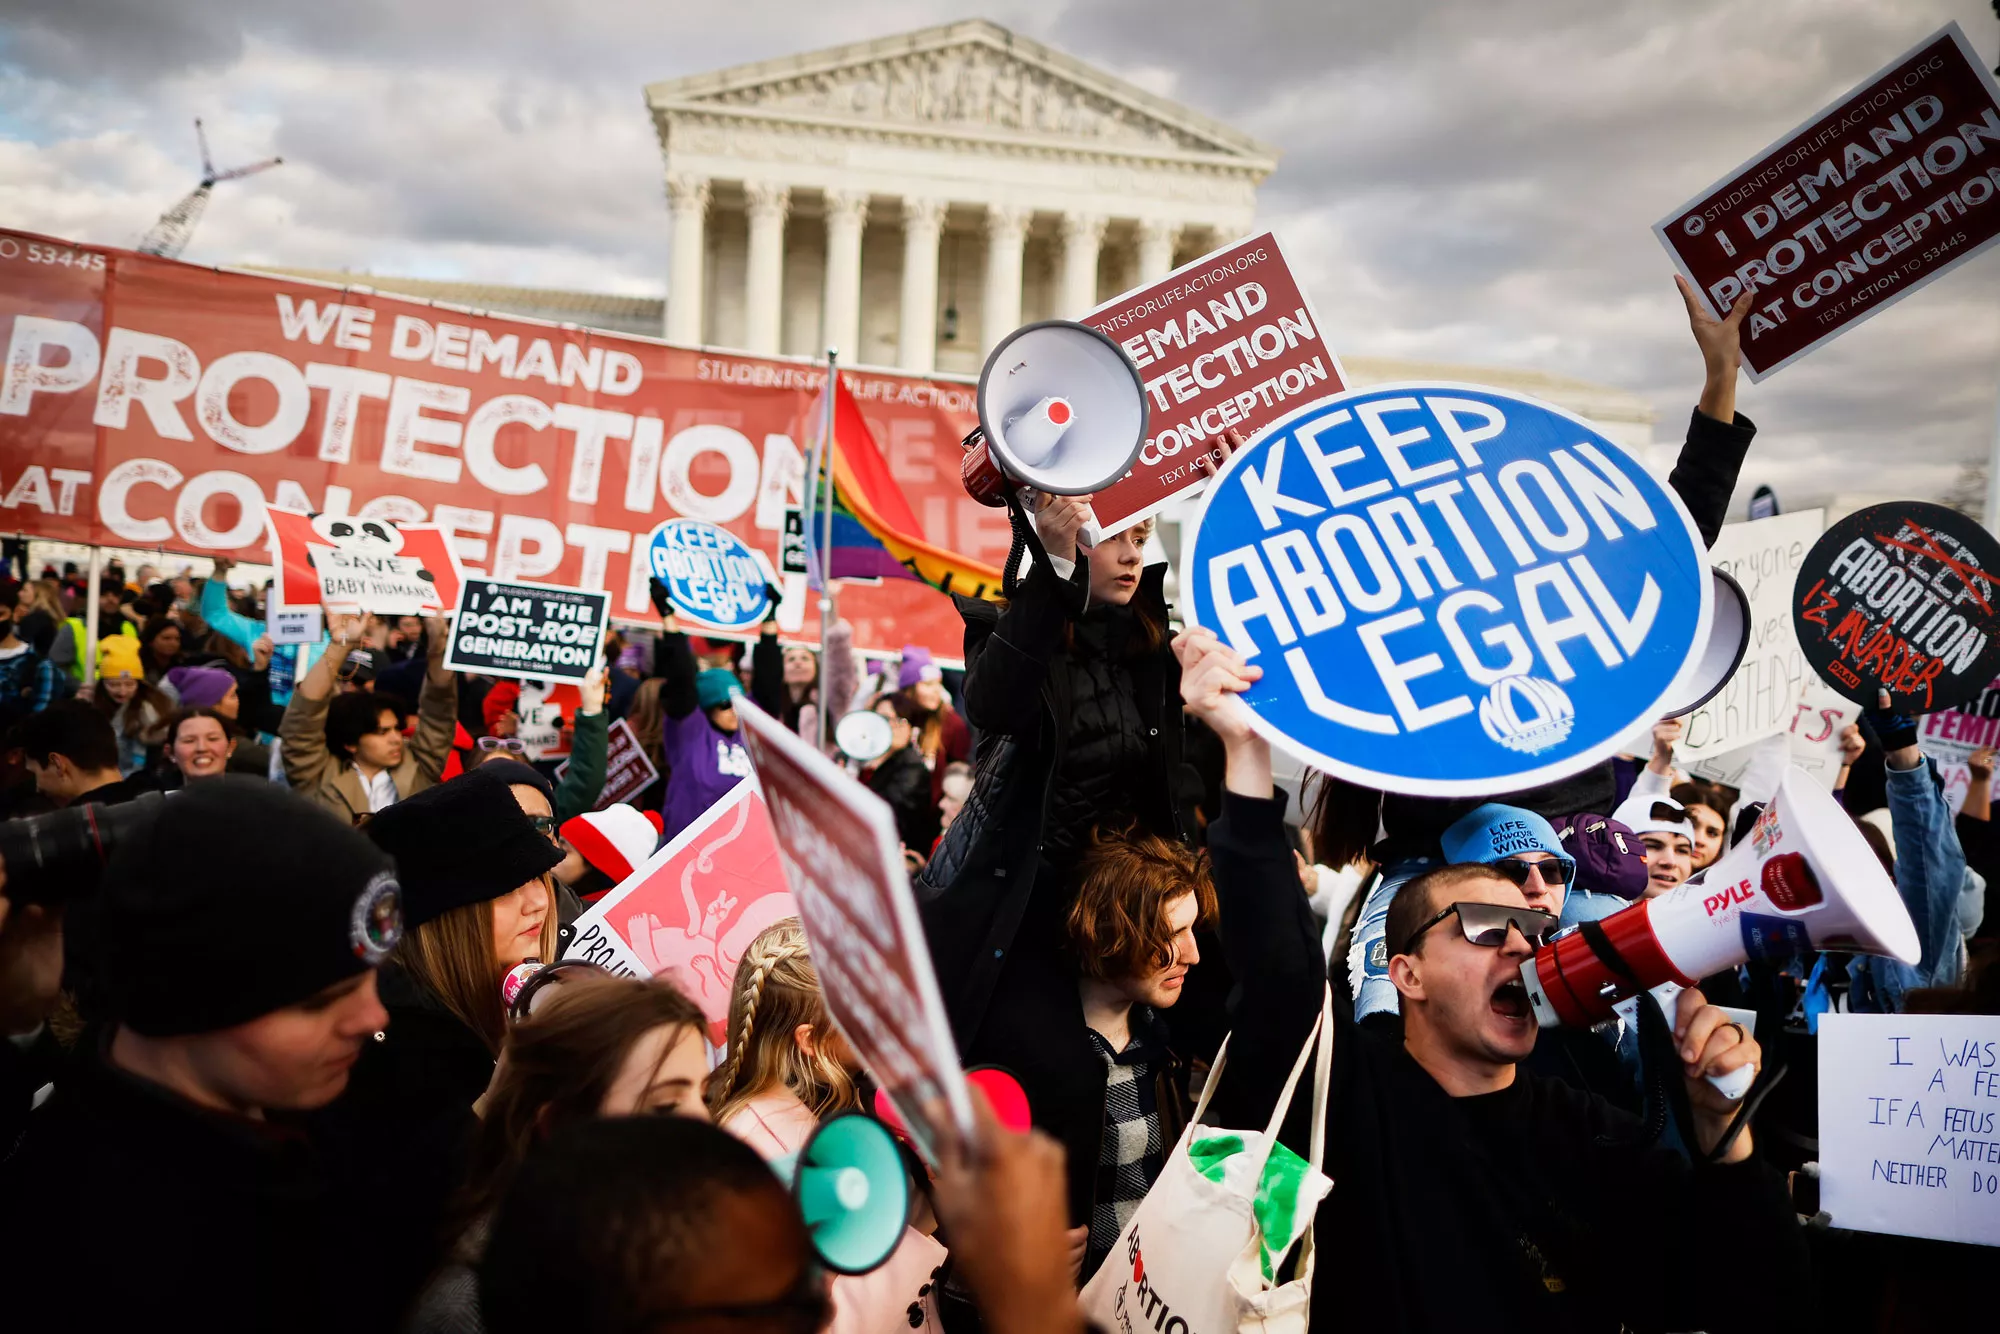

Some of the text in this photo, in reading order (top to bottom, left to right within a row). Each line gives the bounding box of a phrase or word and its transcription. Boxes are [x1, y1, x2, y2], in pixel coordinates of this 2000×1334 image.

[1705, 55, 1944, 222] STUDENTSFORLIFEACTION.ORG
[1715, 94, 1944, 258] I DEMAND
[1709, 107, 2000, 313] PROTECTION
[26, 243, 107, 272] 53445
[1817, 231, 1968, 326] TEXT ACTION TO 53445
[1751, 297, 1788, 341] AT
[276, 293, 644, 397] WE DEMAND
[1145, 306, 1317, 413] TECTION
[0, 313, 807, 531] PROTECTION
[1139, 355, 1329, 467] CONCEPTION
[1158, 465, 1187, 487] TEXT
[1240, 396, 1507, 531] KEEP
[8, 465, 93, 516] AT
[98, 456, 807, 633] COEPTIN
[663, 523, 735, 553] KEEP
[1208, 443, 1658, 659] ABORTION
[330, 550, 406, 576] SAVE
[652, 546, 766, 587] ABORTION
[324, 576, 436, 600] BABY HUMANS
[470, 592, 594, 624] I AM THE
[670, 576, 762, 613] LEGAL
[1828, 536, 1989, 676] ABORTION
[458, 610, 599, 647] POST-ROE
[1283, 554, 1663, 735] LEGAL
[458, 634, 592, 667] GENERATION
[1827, 608, 1945, 710] MURDER
[1925, 708, 2000, 750] FEMI
[1489, 820, 1527, 837] LIFE
[1492, 830, 1534, 846] always
[1703, 878, 1756, 917] PYLE
[1888, 1037, 1997, 1068] I WAS
[1928, 1068, 1946, 1093] A
[1868, 1097, 1996, 1134] IF A FETUS
[1927, 1134, 2000, 1165] MATTE
[1872, 1159, 1948, 1189] NEITHER
